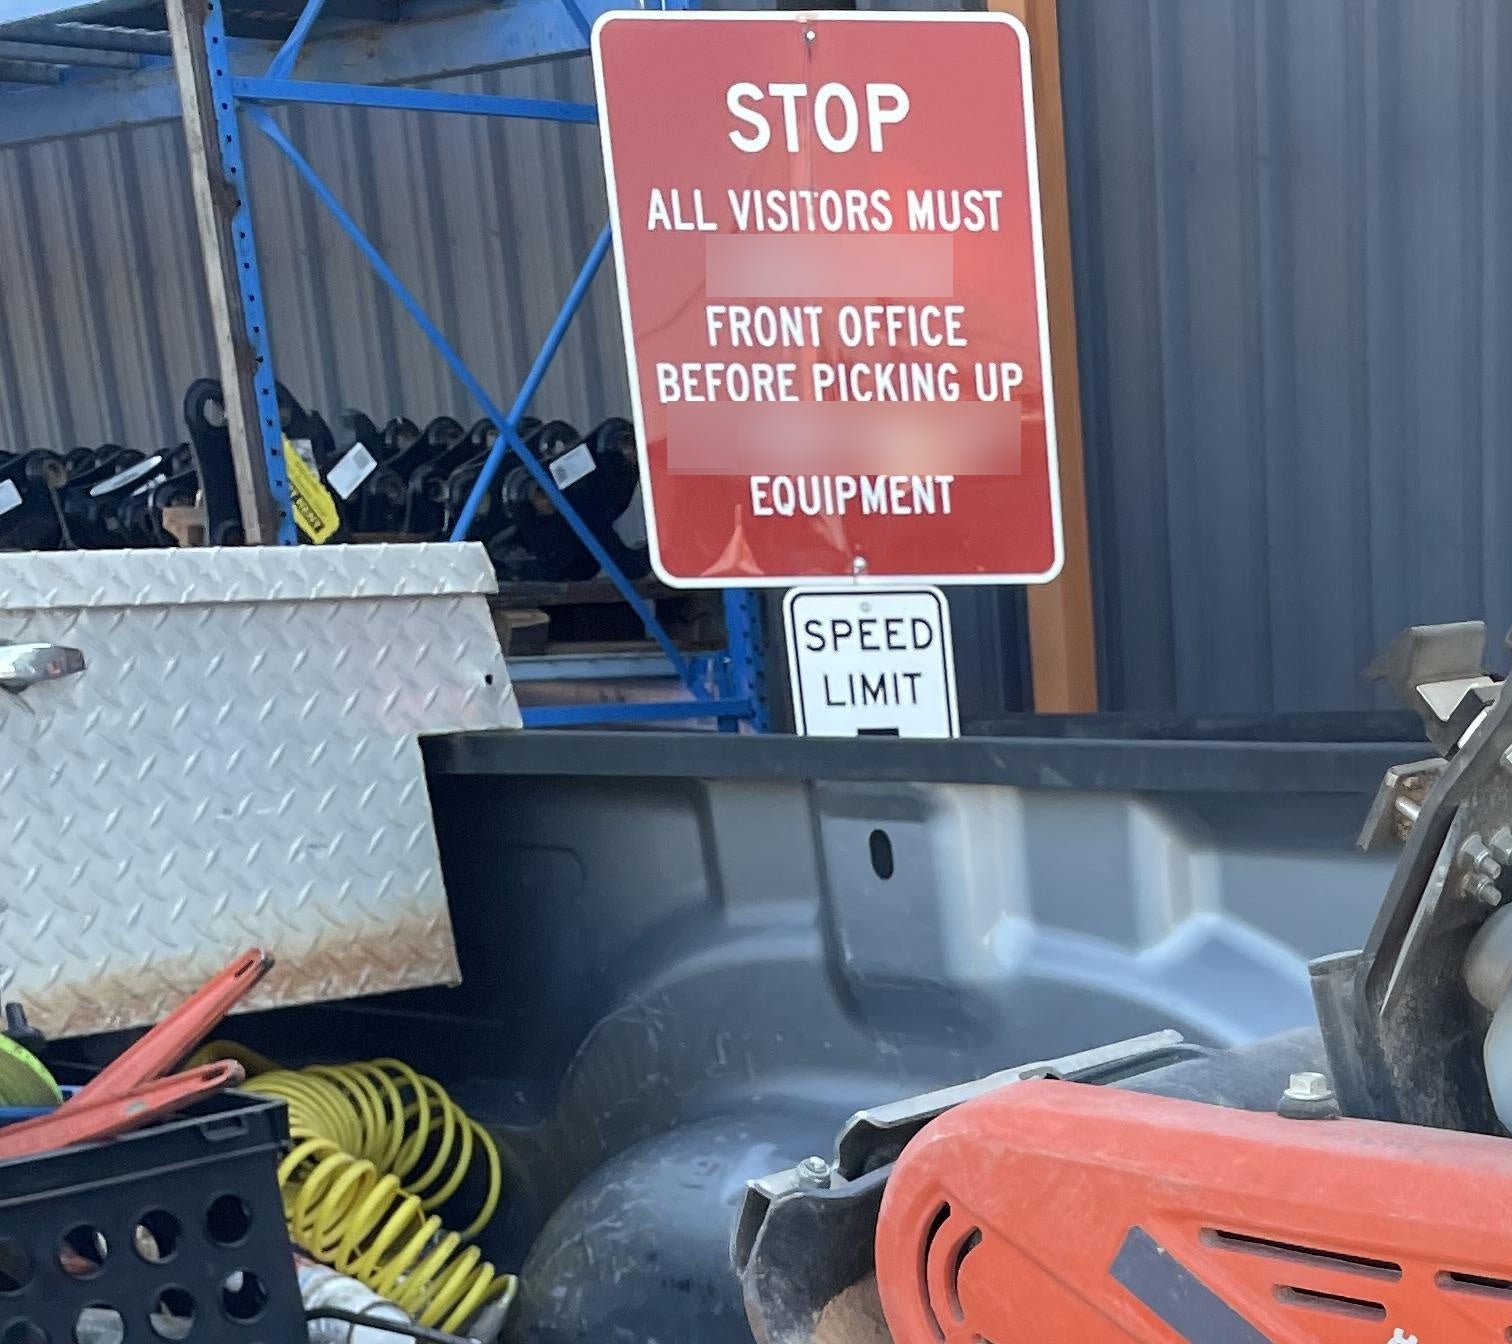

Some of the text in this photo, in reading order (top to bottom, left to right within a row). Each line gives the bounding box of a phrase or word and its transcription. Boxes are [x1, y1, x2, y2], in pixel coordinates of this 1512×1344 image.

[725, 82, 911, 153] STOP
[648, 188, 1003, 232] ALL VISITORS MUST
[705, 305, 968, 347] FRONT OFFICE
[655, 362, 1024, 403] BEFORE PICKING UP
[750, 475, 955, 517] EQUIPMENT
[804, 617, 933, 651] SPEED
[823, 672, 922, 706] LIMIT
